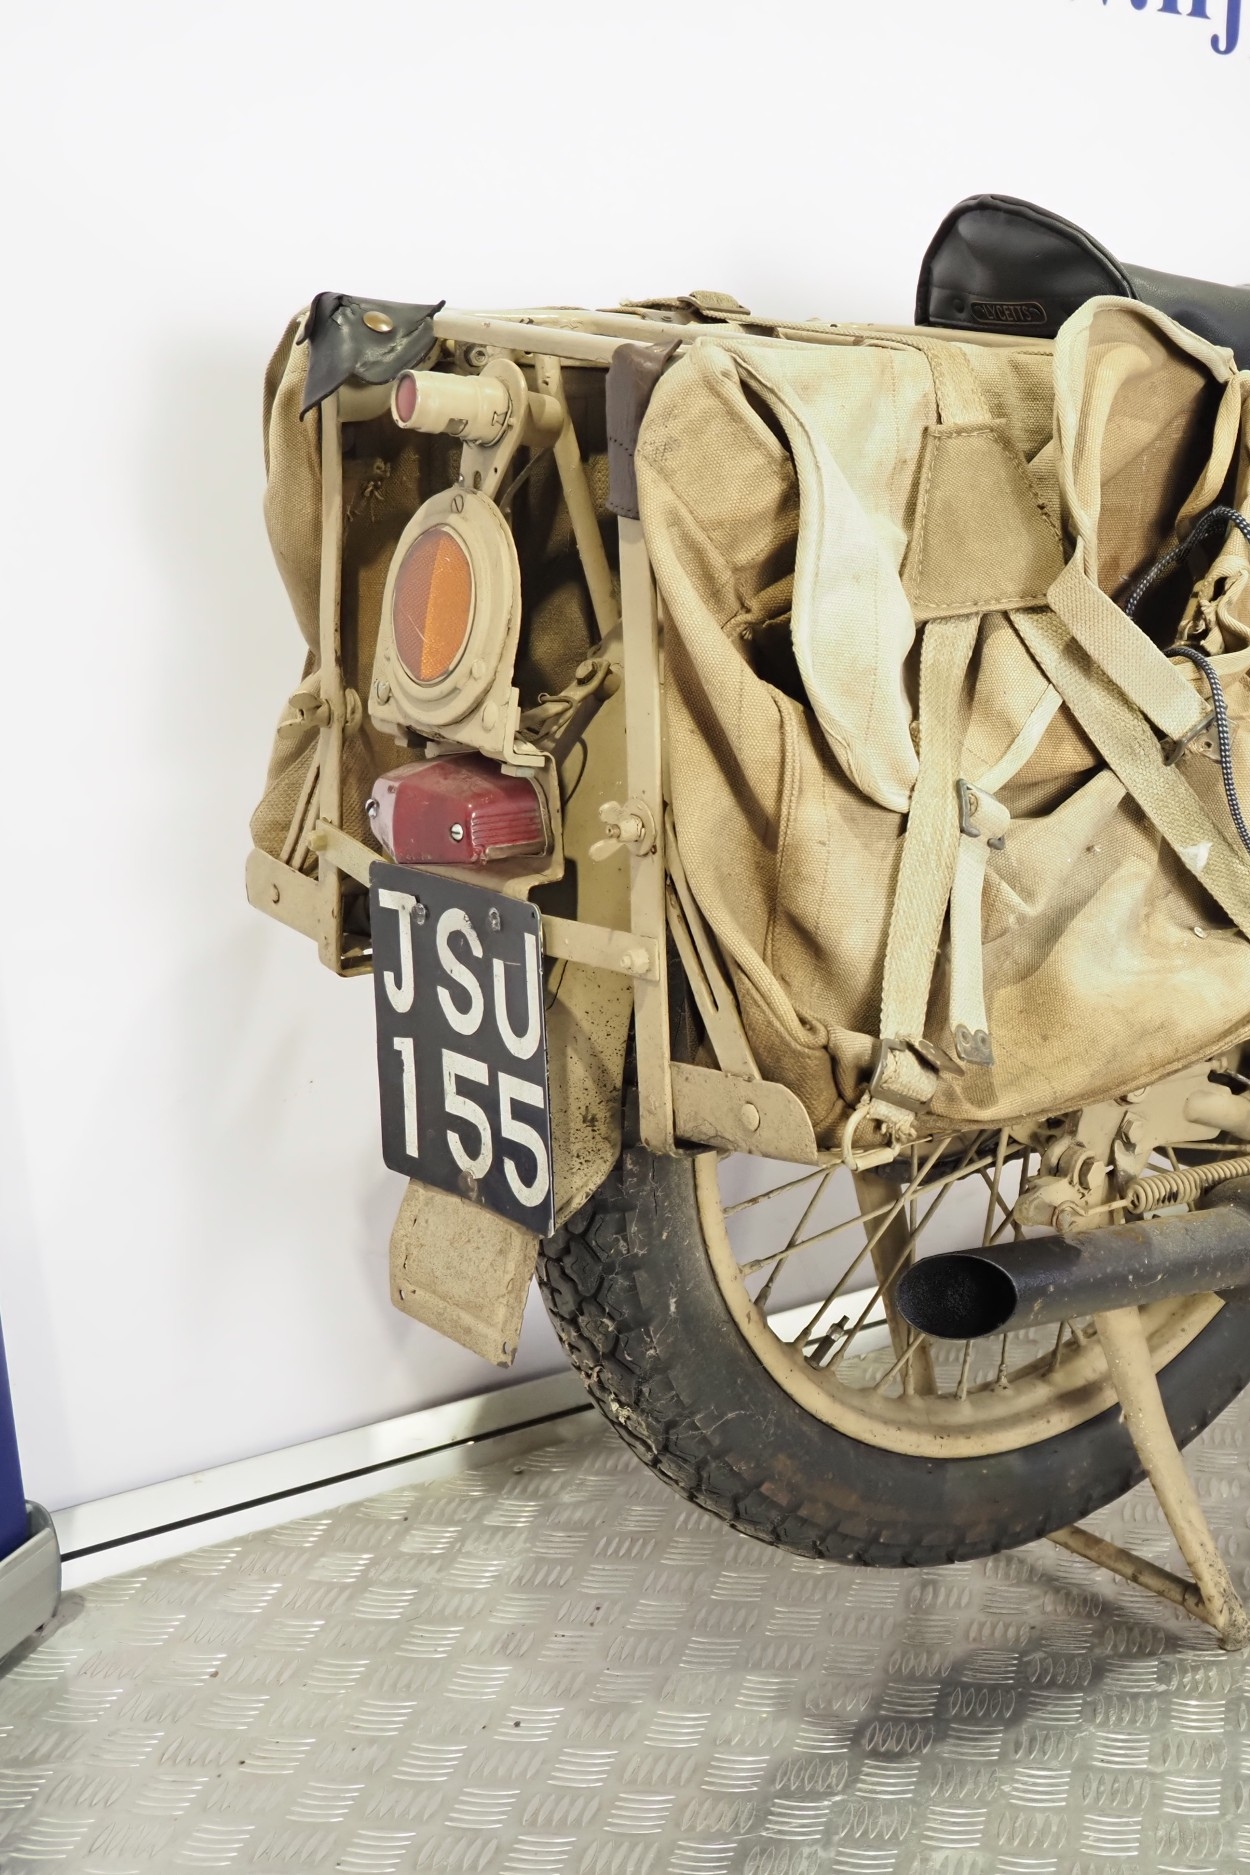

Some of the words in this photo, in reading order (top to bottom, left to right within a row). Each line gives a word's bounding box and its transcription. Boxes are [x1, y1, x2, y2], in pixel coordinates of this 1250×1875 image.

[985, 304, 1032, 322] LYCETTS
[378, 888, 541, 1059] JSU
[394, 1037, 549, 1207] 155
